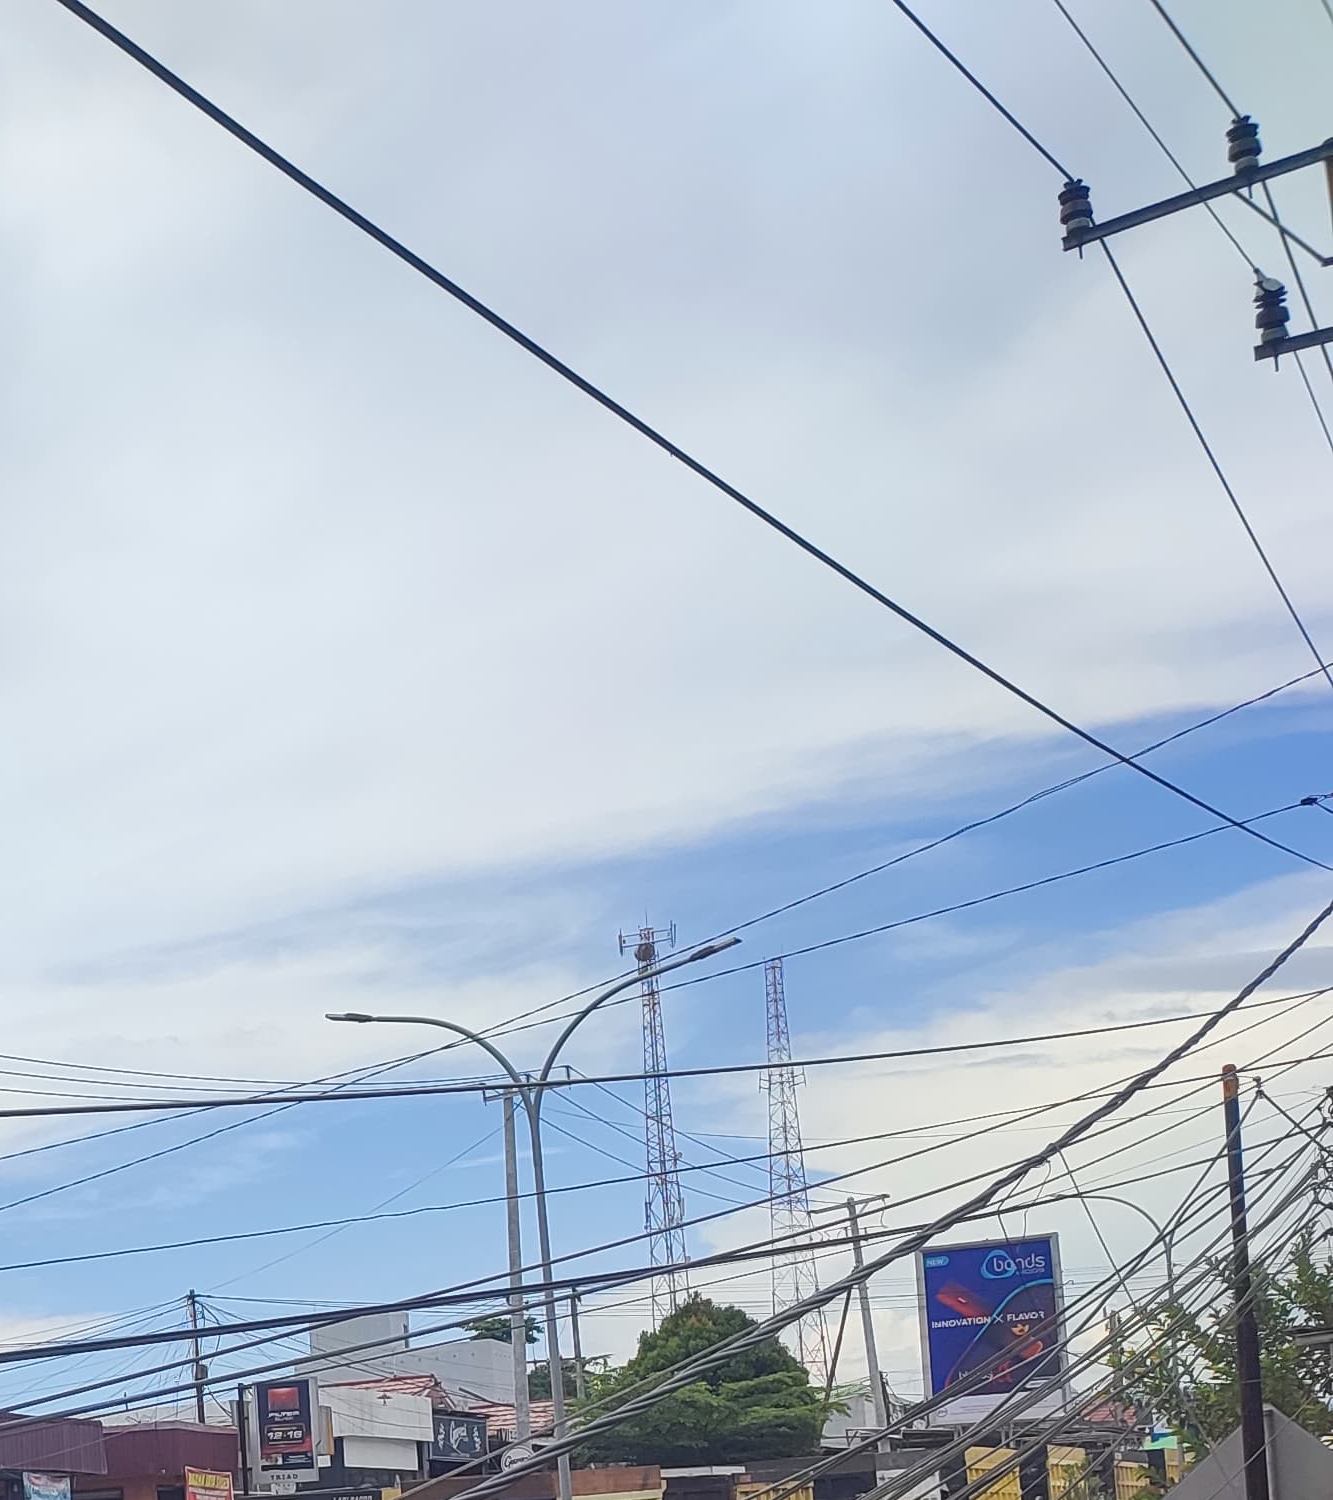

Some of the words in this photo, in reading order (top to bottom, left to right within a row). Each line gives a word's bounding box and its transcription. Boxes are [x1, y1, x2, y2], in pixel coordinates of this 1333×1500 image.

[993, 1253, 1045, 1272] bonds
[932, 1316, 991, 1329] INNOVATION
[1006, 1311, 1045, 1322] FLAVOR
[270, 1473, 299, 1481] TRIAD
